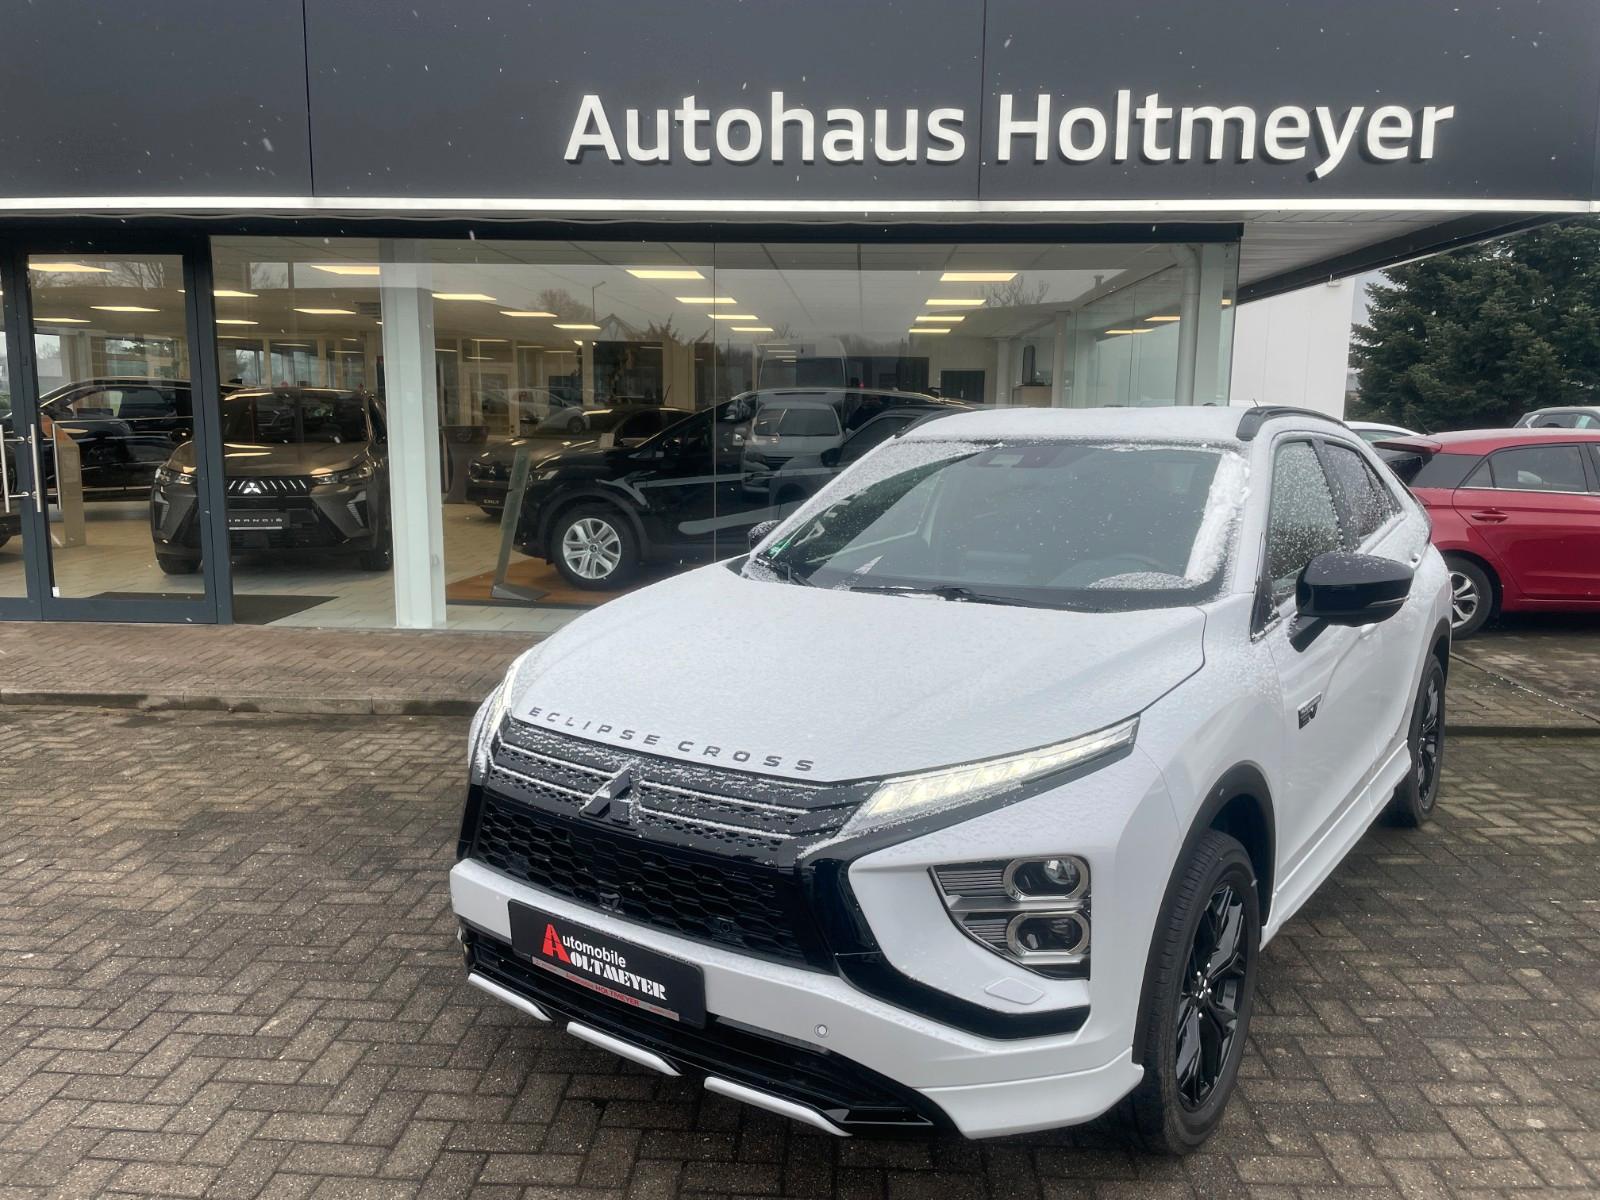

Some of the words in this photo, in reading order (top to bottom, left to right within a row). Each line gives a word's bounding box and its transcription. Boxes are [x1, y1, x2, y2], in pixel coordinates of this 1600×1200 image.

[564, 91, 967, 164] Autohaus
[997, 88, 1454, 180] Holtmeyer
[528, 706, 661, 746] ECLIPSE
[677, 740, 815, 772] CROSS
[542, 923, 627, 968] Automobile
